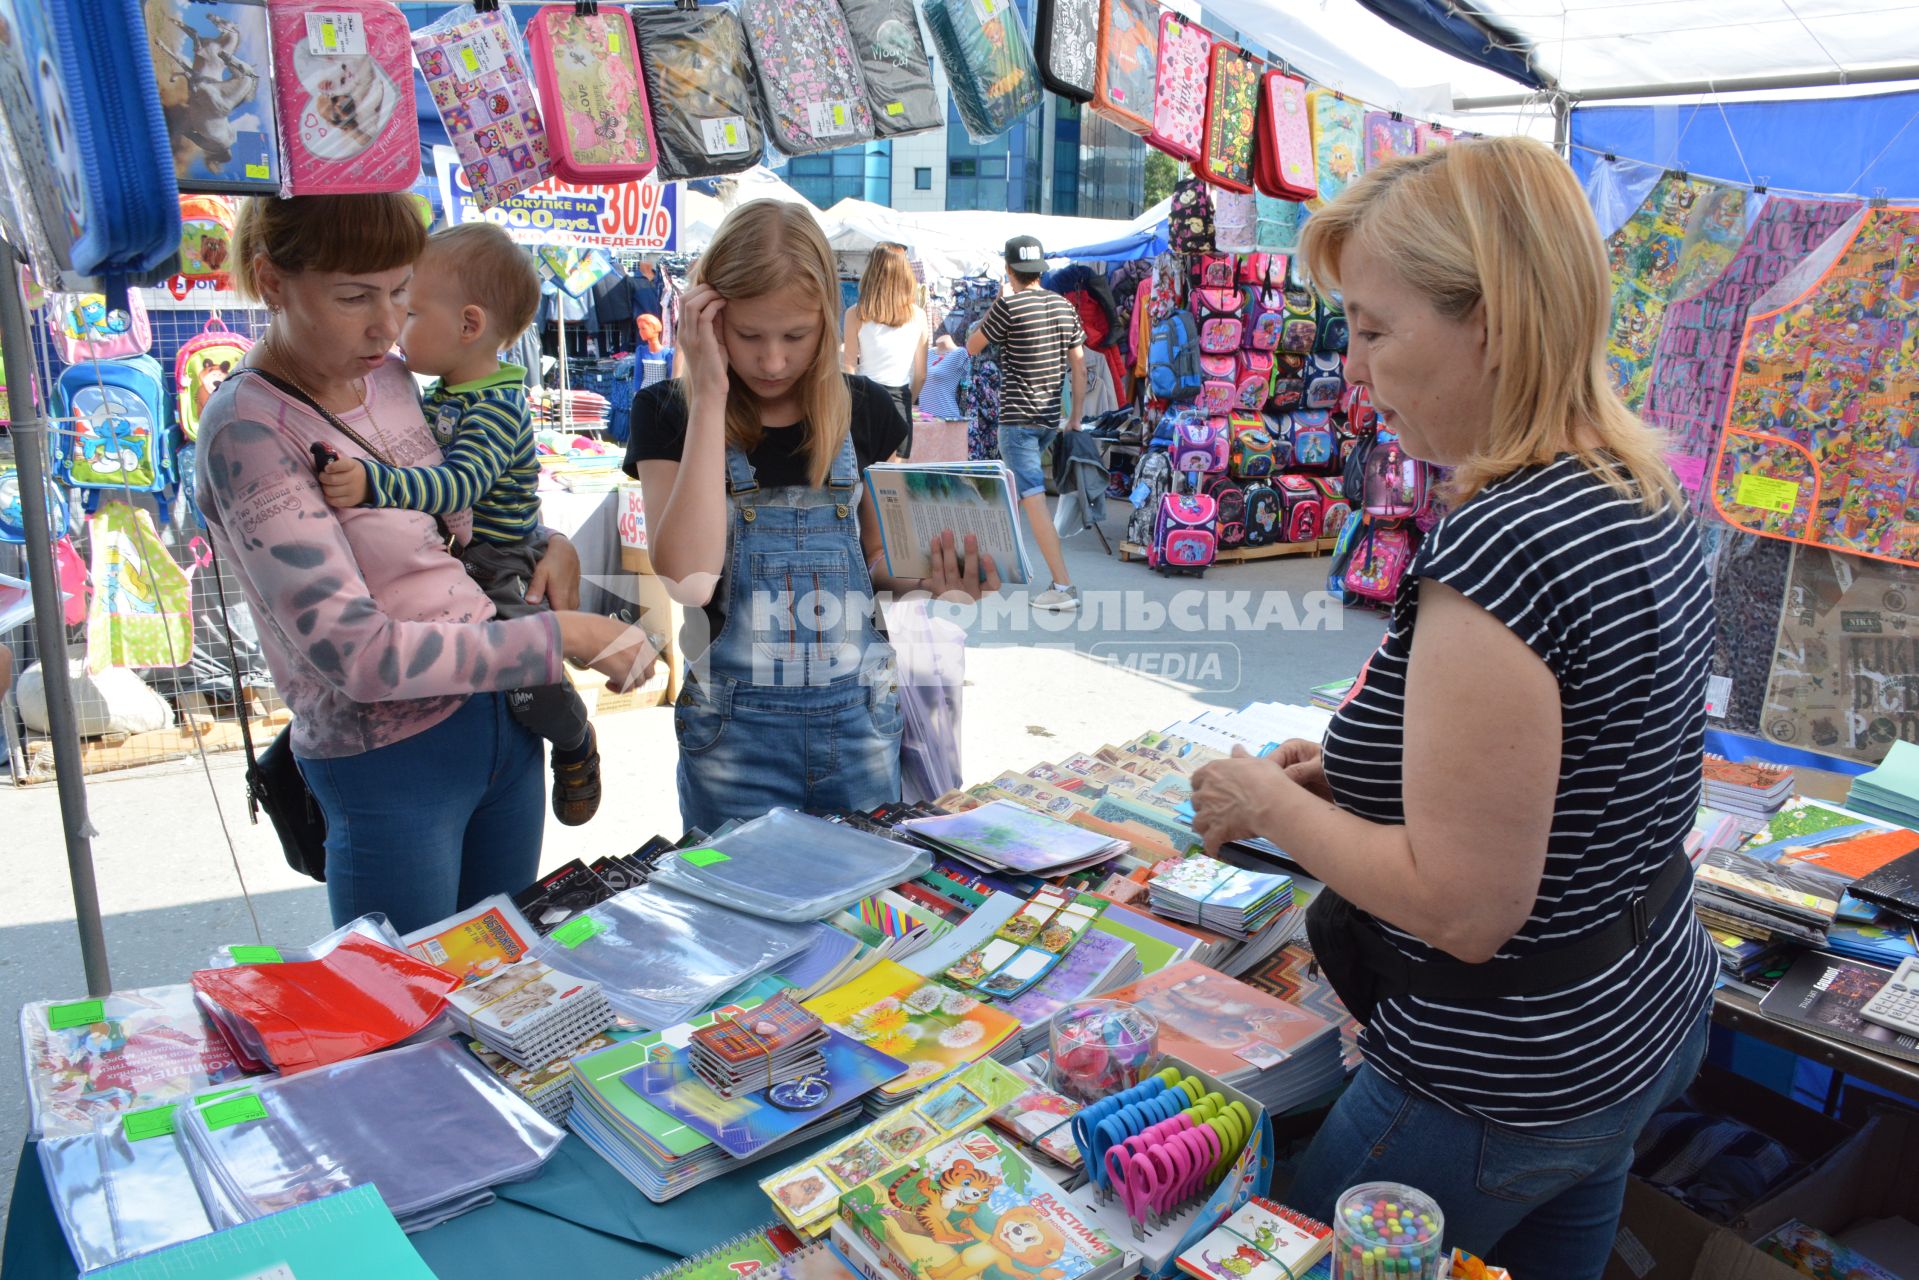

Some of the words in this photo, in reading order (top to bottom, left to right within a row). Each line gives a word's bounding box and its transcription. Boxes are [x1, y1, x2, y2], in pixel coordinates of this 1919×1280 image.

[1176, 77, 1193, 118] Kitty
[502, 198, 572, 211] ПОКУПКЕ
[576, 202, 598, 213] НА
[601, 181, 669, 238] 30%
[554, 218, 596, 231] руб.
[587, 234, 664, 247] НЕДЕЛЮ
[252, 487, 291, 512] Millions
[620, 512, 638, 543] 49
[1849, 618, 1874, 627] NIKA
[482, 914, 521, 958] ОБЛОЖКА
[129, 1058, 236, 1088] КОМПЛЕКТ
[1037, 1192, 1112, 1256] ПЛАСТИЛИН
